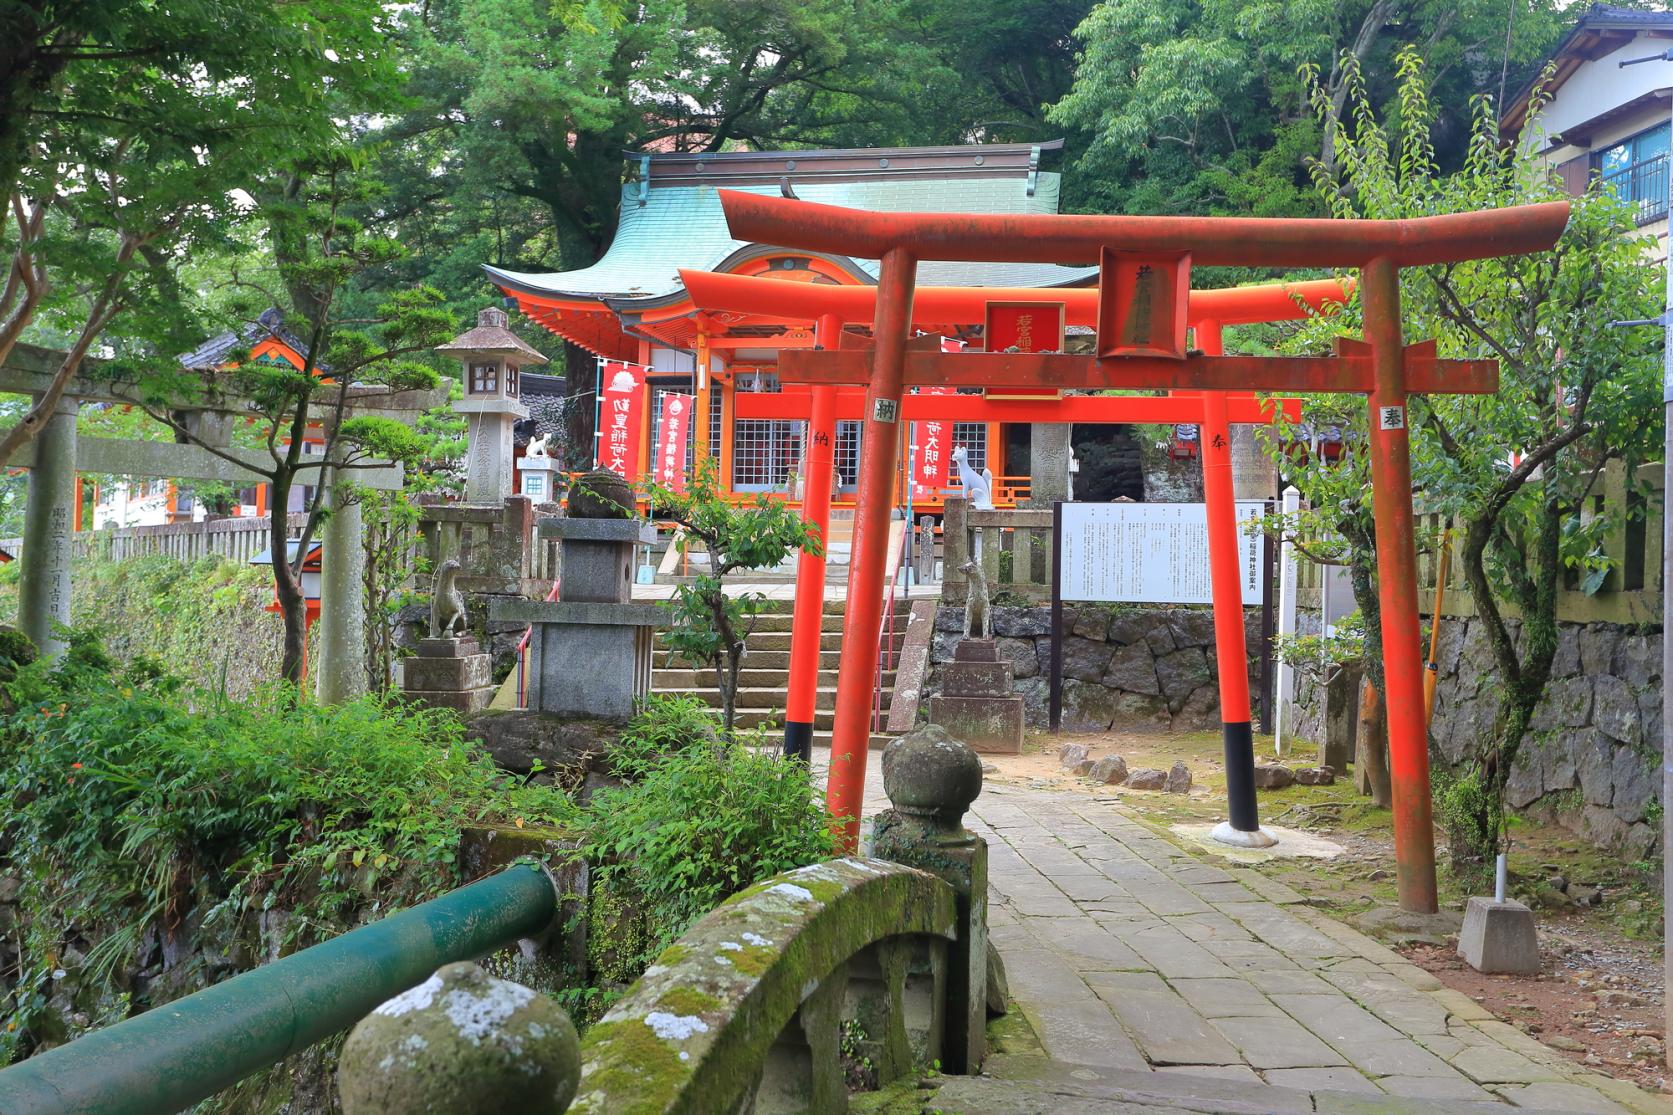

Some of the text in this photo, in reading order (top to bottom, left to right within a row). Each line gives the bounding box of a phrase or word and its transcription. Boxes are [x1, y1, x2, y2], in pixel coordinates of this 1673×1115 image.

[877, 400, 894, 420] 納
[1384, 407, 1402, 428] 奉
[814, 431, 828, 447] 納
[1211, 433, 1227, 451] 奉
